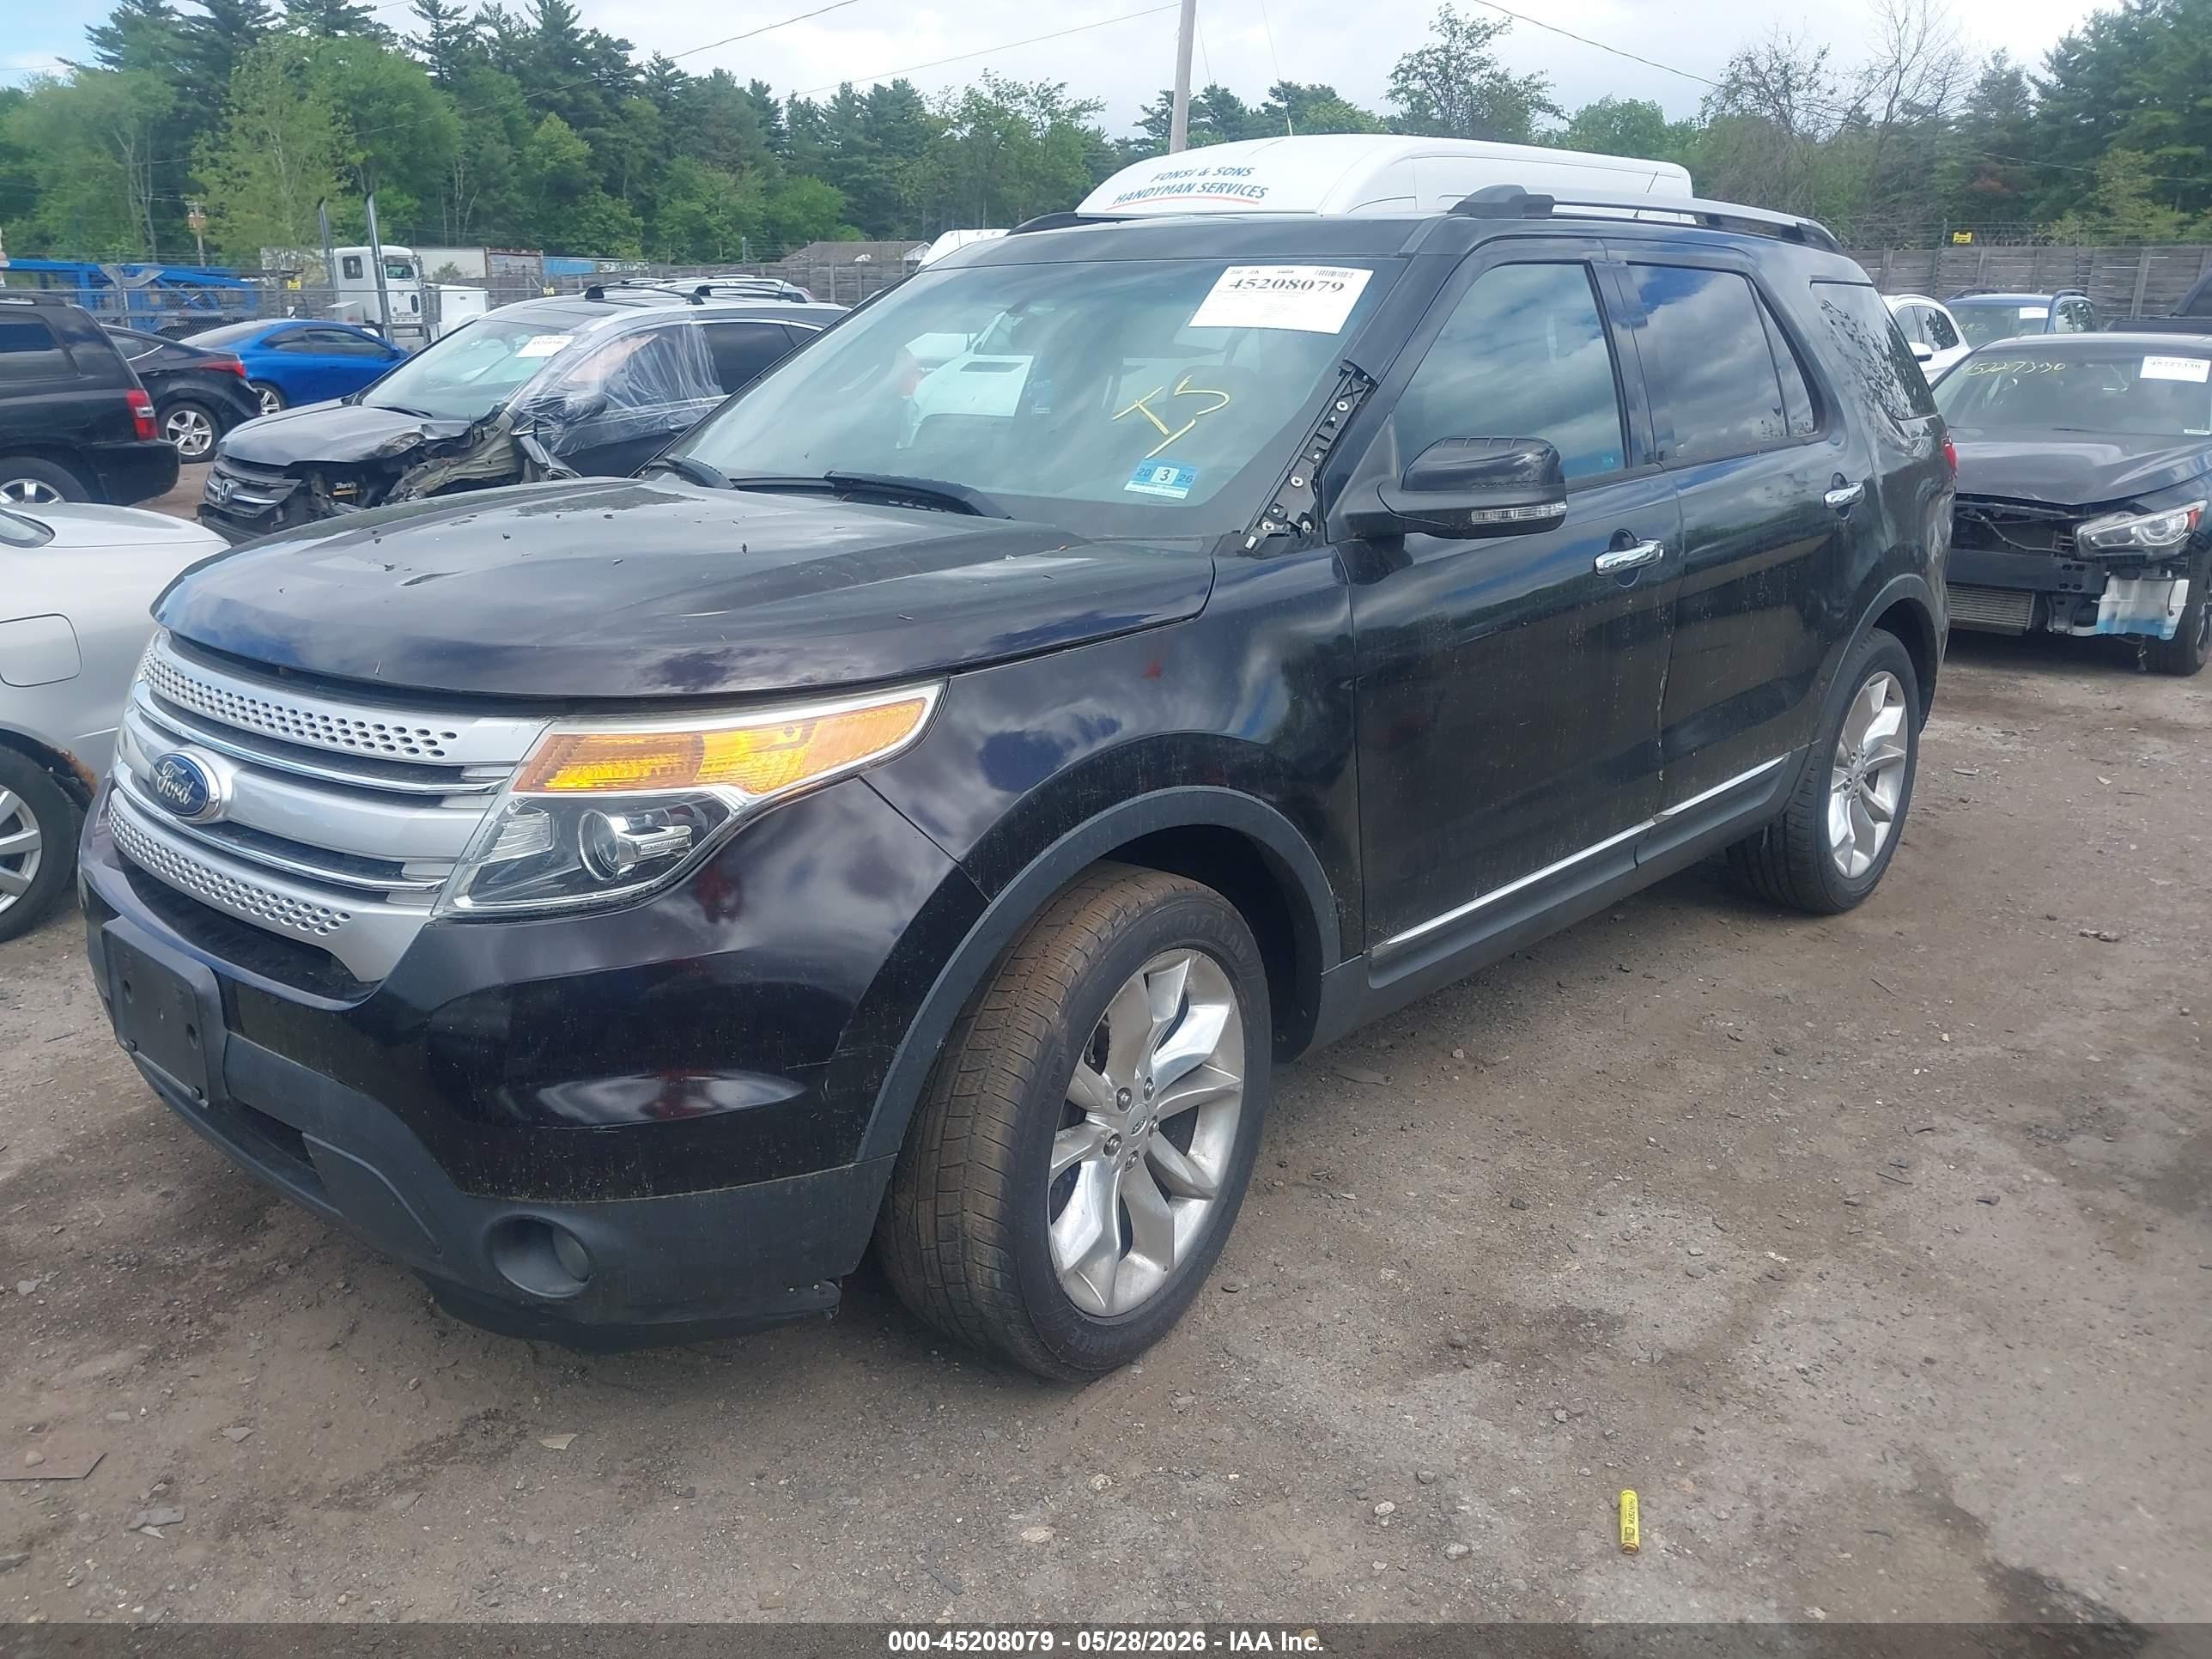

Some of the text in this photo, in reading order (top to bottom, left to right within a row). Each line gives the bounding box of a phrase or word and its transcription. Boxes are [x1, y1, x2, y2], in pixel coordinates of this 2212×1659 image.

[1199, 167, 1210, 177] &
[1212, 167, 1256, 177] SONS
[1113, 182, 1269, 205] HANDYMAN SERVICES
[1229, 278, 1346, 293] 45208079
[1136, 467, 1194, 483] 20 3 26
[157, 761, 195, 805] Ford
